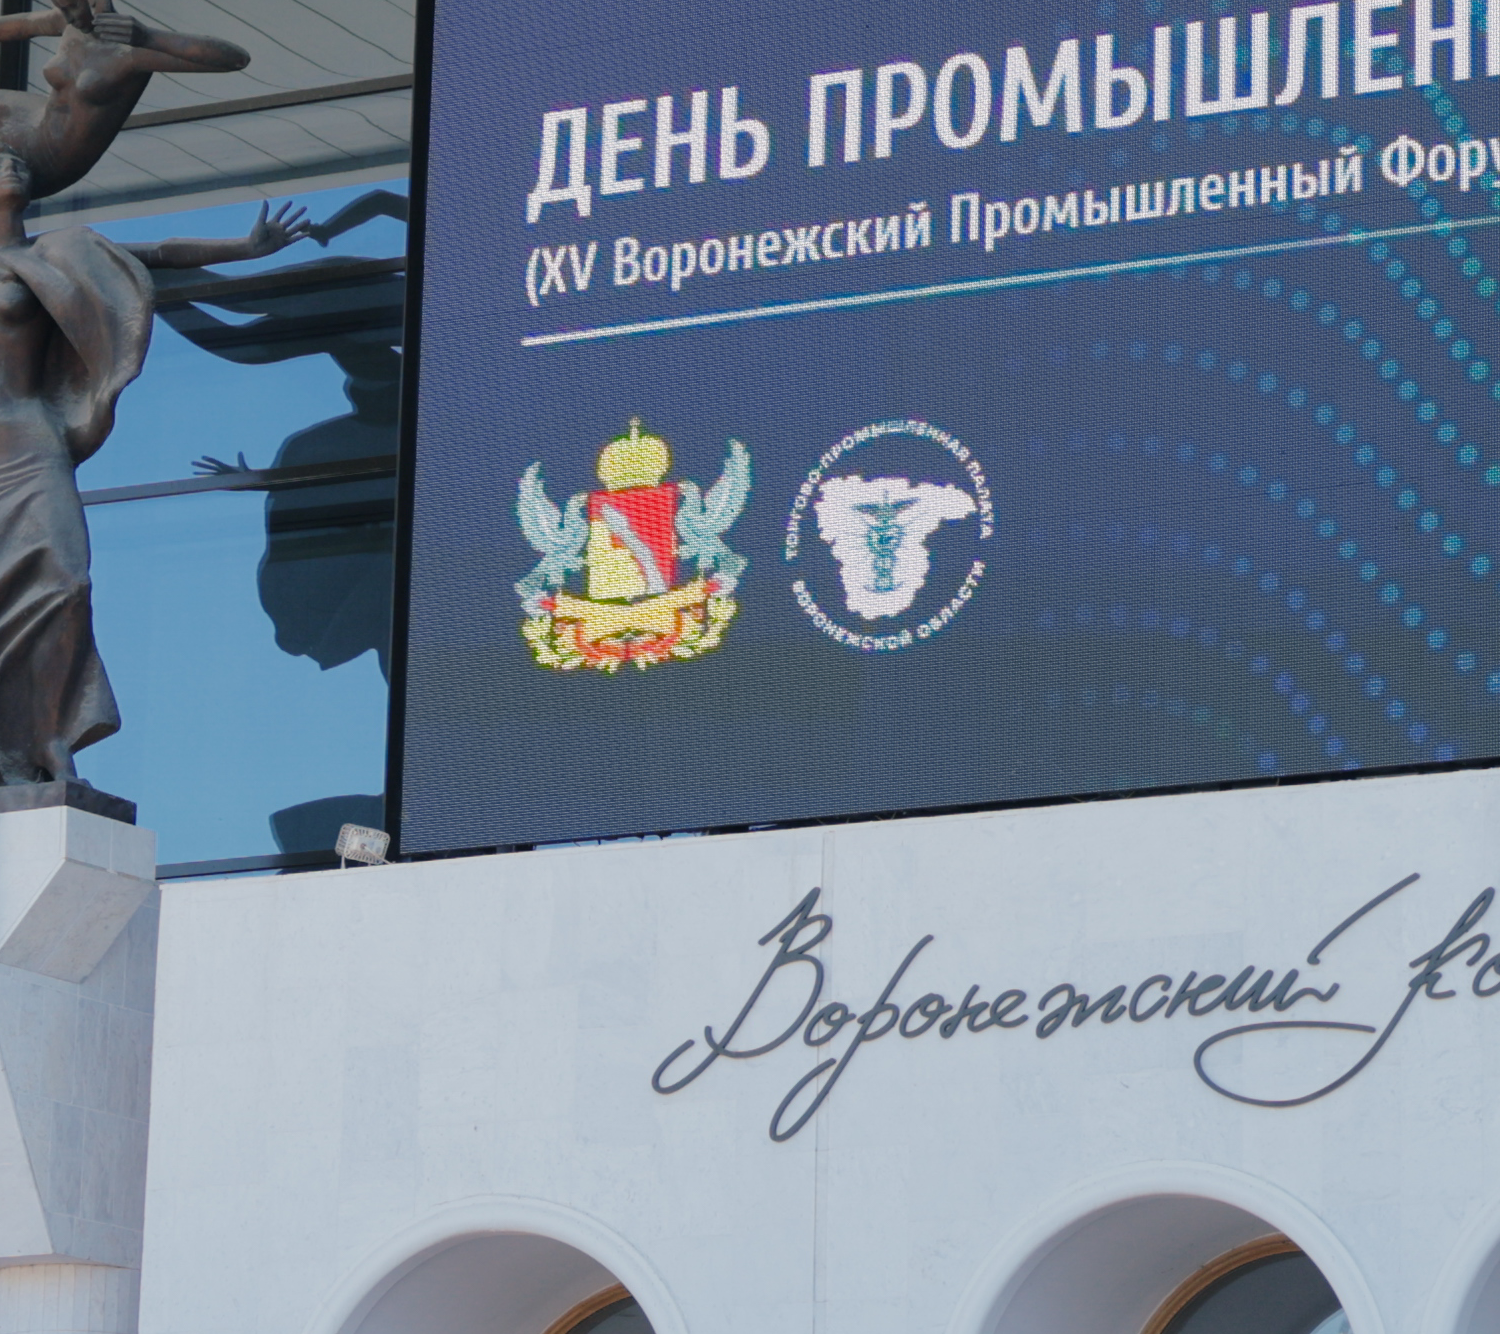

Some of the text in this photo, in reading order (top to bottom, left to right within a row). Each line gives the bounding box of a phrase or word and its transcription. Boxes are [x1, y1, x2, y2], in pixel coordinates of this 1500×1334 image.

[526, 85, 771, 223] ДЕНЬ
[524, 247, 598, 307] (XV
[612, 201, 932, 292] Воронежский
[950, 146, 1363, 253] Промышленный
[964, 459, 994, 540] ПАЛАТА
[916, 560, 986, 641] ОБЛАСТИ
[652, 873, 1420, 1143] Воронежский
